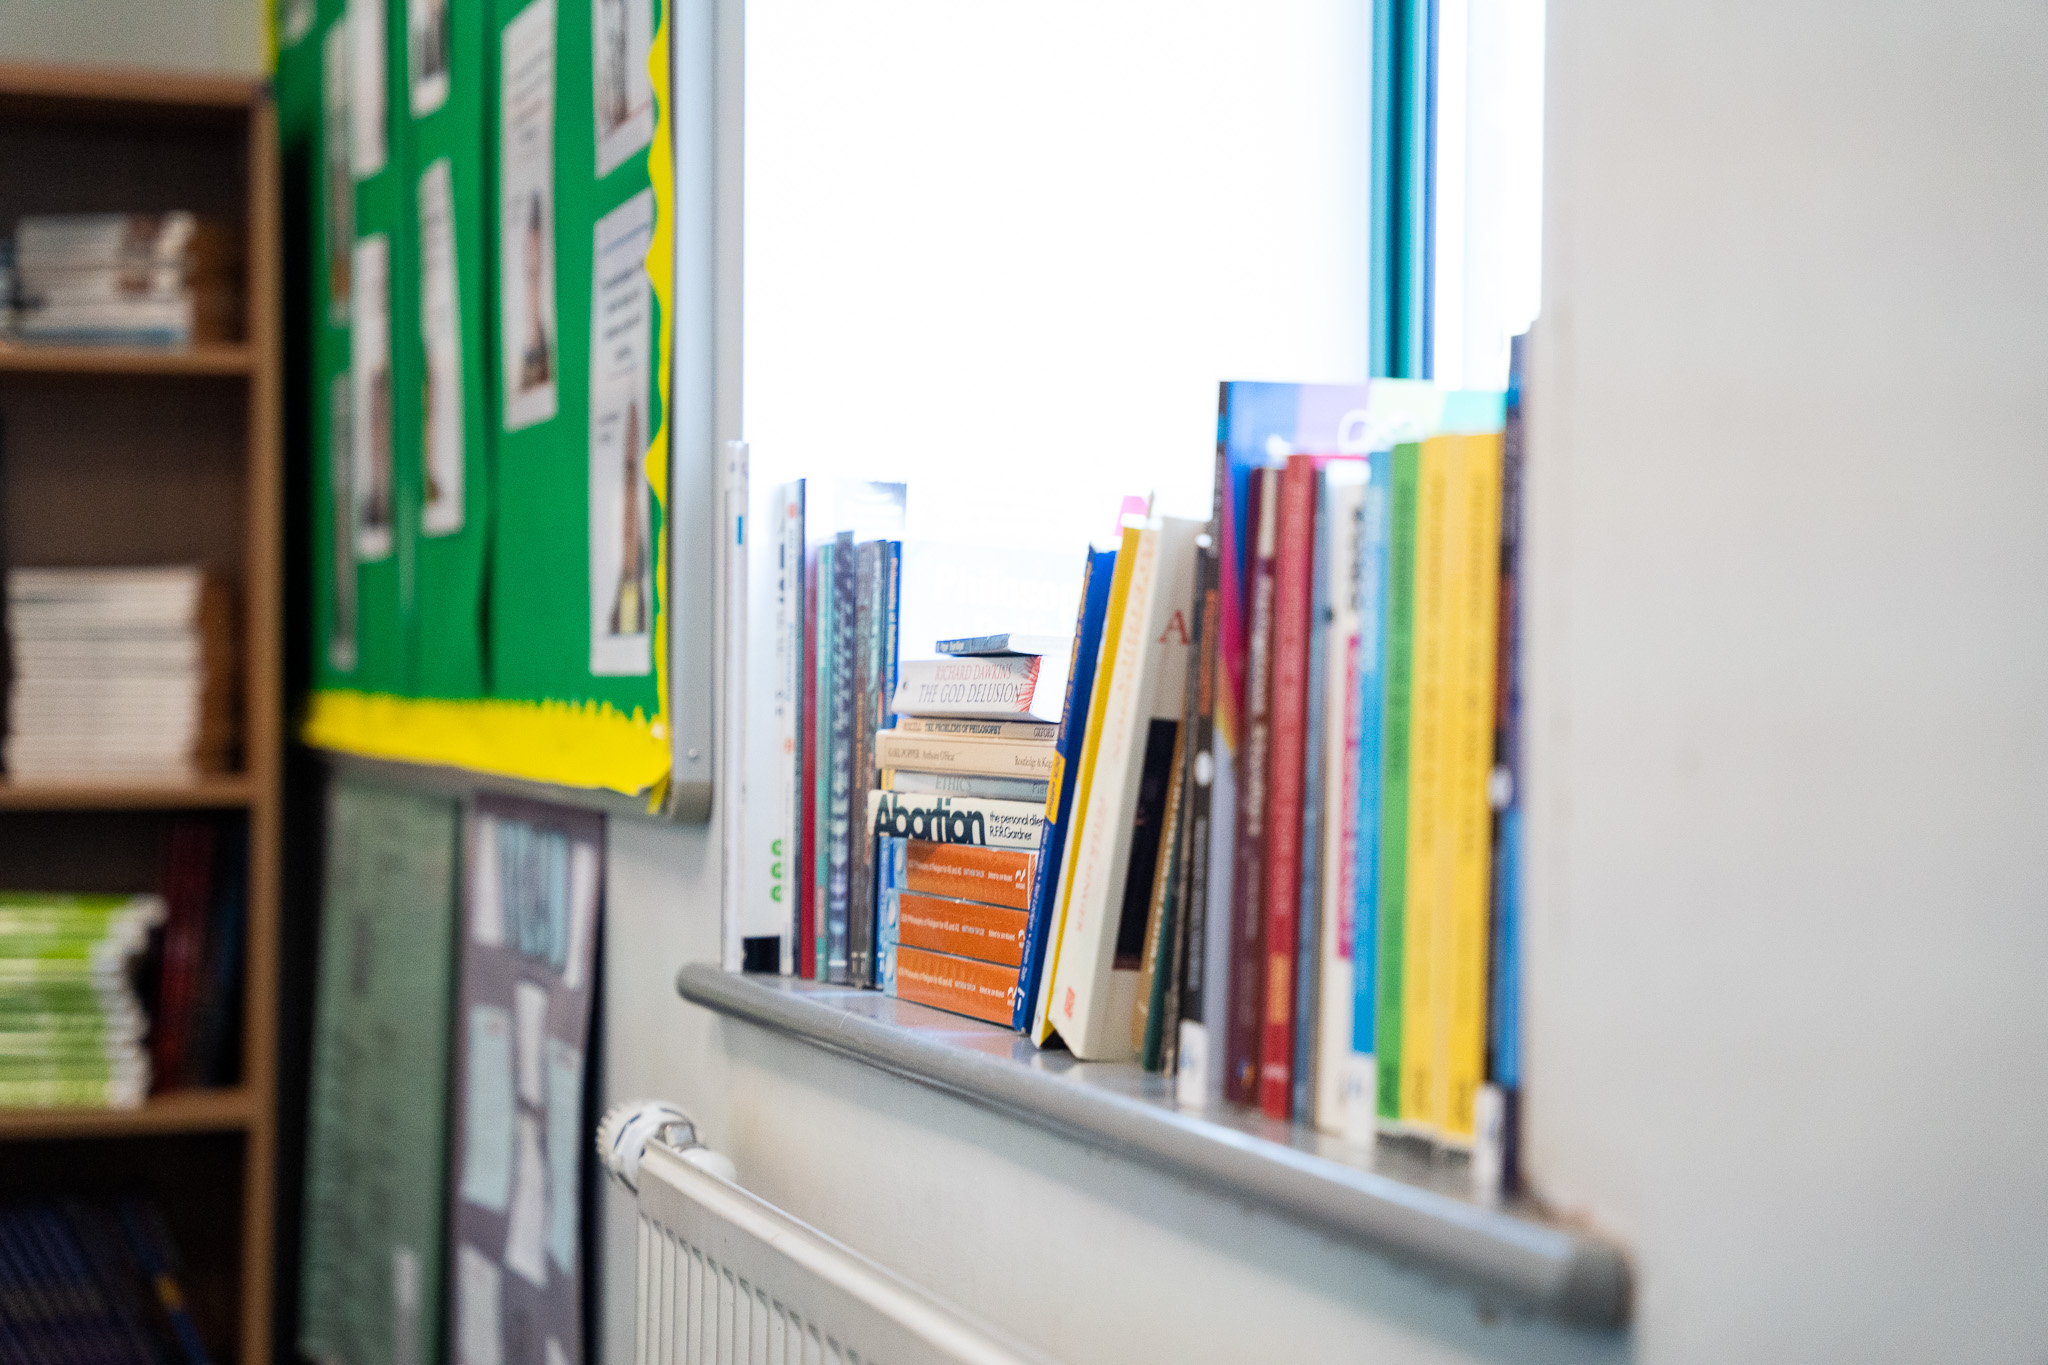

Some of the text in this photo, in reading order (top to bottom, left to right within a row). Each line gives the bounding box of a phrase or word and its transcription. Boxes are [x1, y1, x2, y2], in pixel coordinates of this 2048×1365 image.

[935, 663, 1013, 681] RICHARD DAWKINS
[918, 682, 1023, 703] THE GOD DELUSION
[934, 723, 961, 733] PROBLEMS
[961, 724, 968, 733] OF
[969, 724, 1002, 735] PHILOSOPHY
[1033, 727, 1055, 738] OXFORD
[1014, 755, 1036, 769] Routledge
[935, 775, 972, 792] ETHICS
[875, 793, 986, 844] Abortion
[989, 811, 1000, 822] the
[999, 813, 1029, 825] personal
